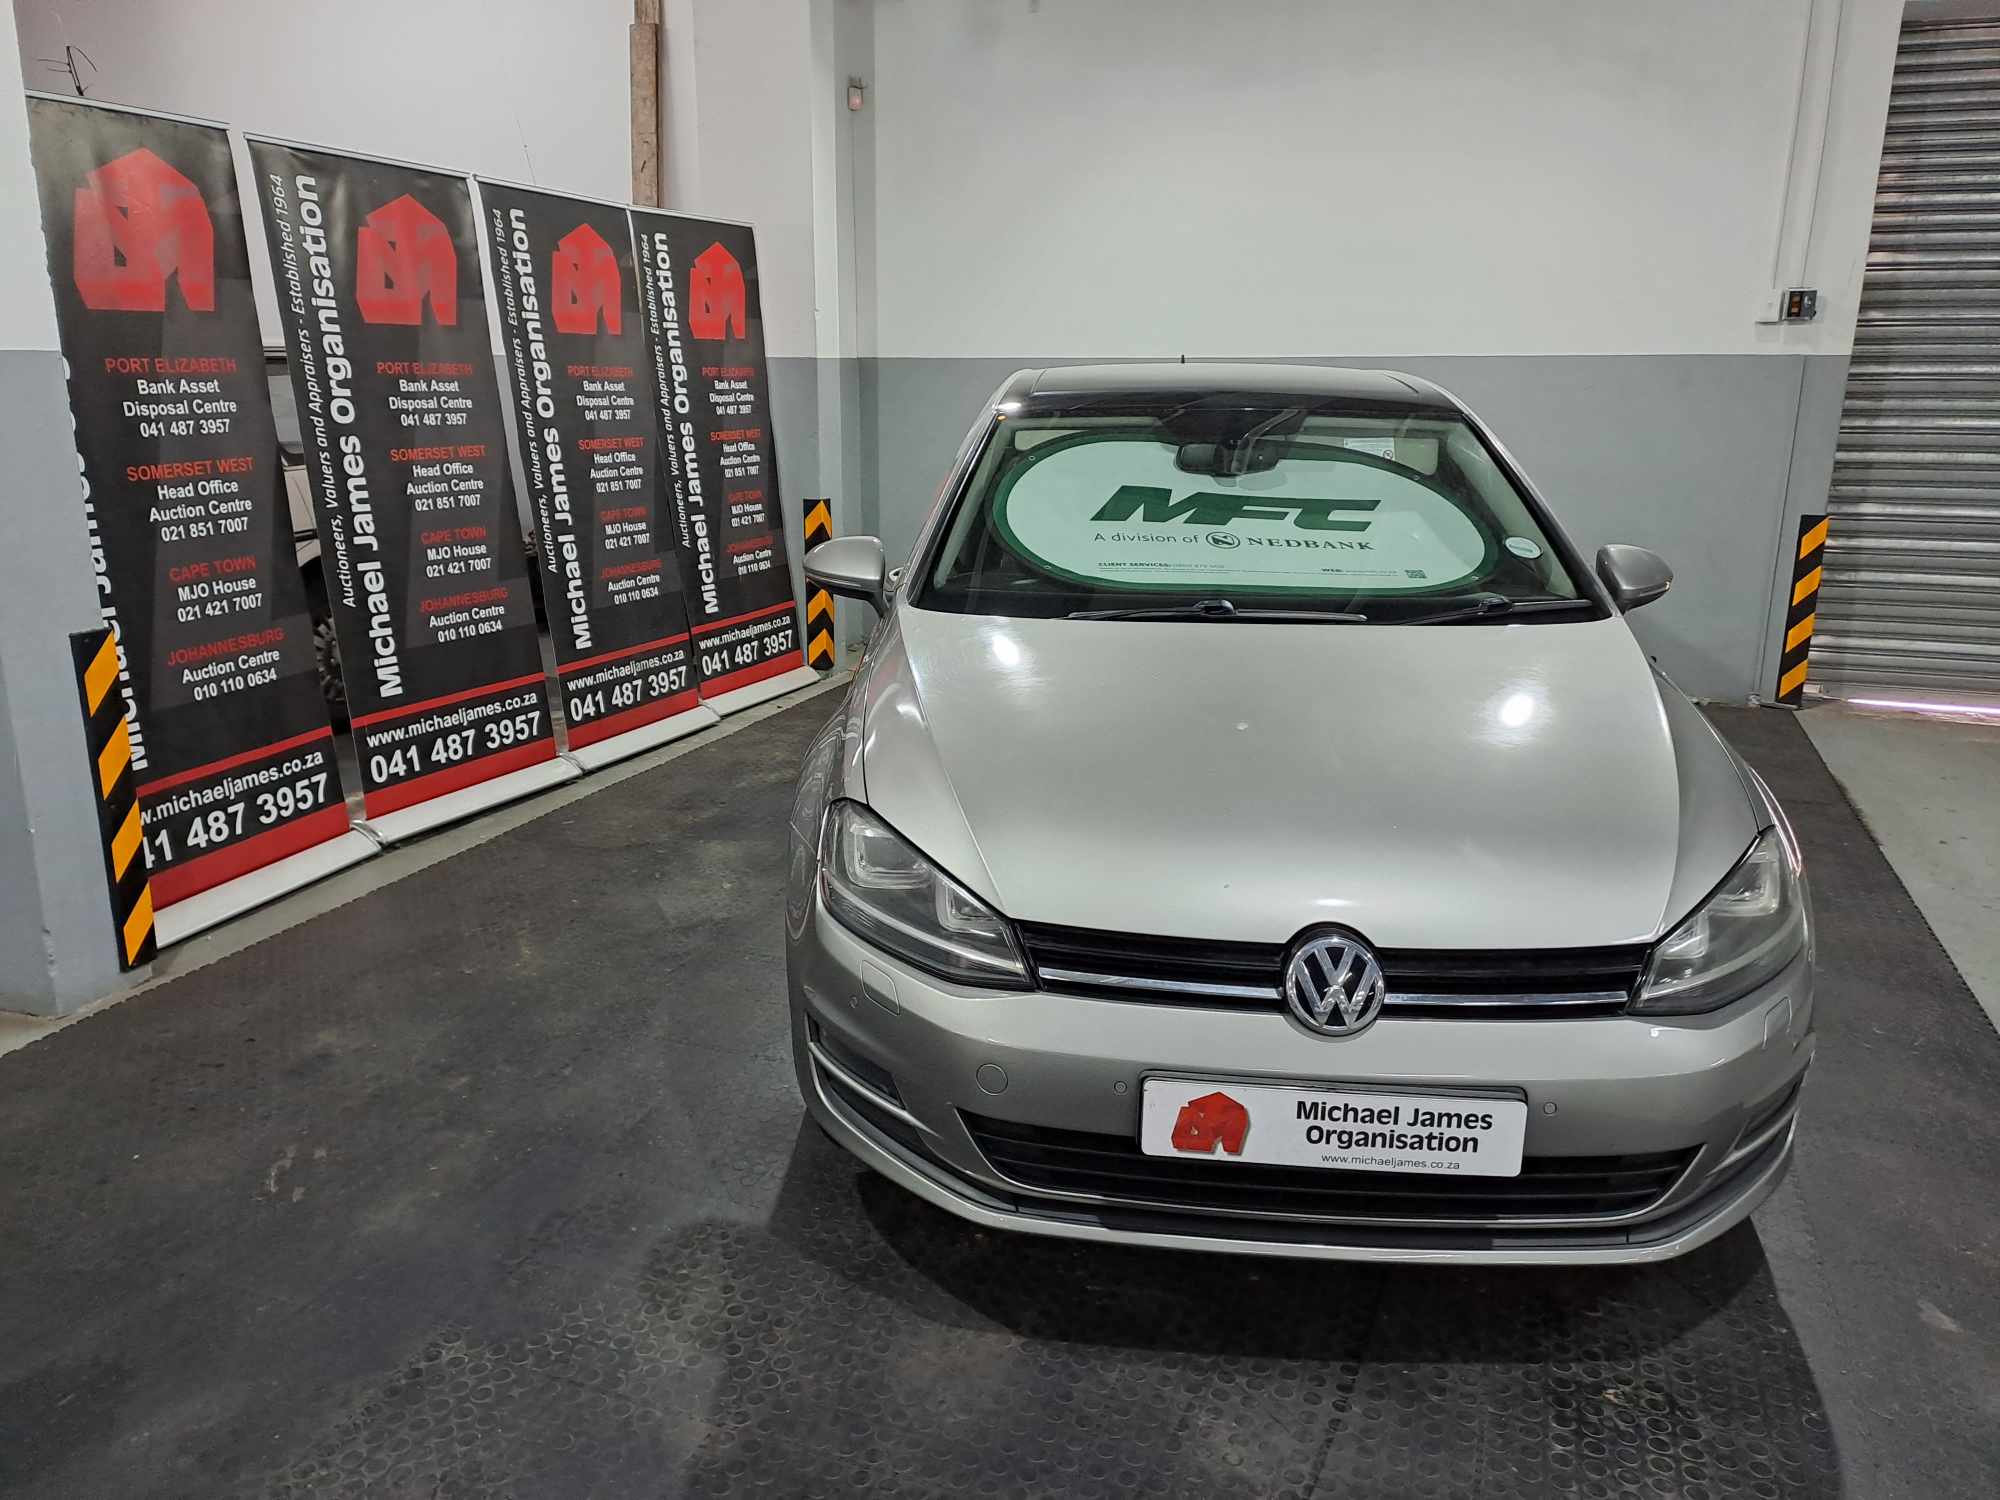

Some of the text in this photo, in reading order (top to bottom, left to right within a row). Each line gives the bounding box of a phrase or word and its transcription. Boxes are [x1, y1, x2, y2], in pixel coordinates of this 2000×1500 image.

[640, 234, 651, 264] 1964
[643, 265, 660, 336] Established
[105, 357, 236, 373] PORT ELIZABETH
[376, 362, 410, 375] PORT
[654, 342, 671, 408] Appraisers
[137, 378, 220, 395] Bank Asset
[269, 174, 356, 608] Auctioneers, Valuers and Appraisers Established 1964
[399, 379, 460, 392] Bank Asset
[492, 208, 558, 574] Auctioneers, Valuers and Appraisers Established 1964
[583, 380, 625, 392] Bank Asset
[122, 400, 237, 419] Disposal Centre
[388, 396, 472, 411] Disposal Centre
[576, 396, 634, 408] Disposal Centre
[400, 413, 467, 426] 041 487 3957
[584, 410, 598, 420] 041
[614, 409, 631, 420] 3957
[661, 408, 673, 431] and
[140, 418, 230, 438] 041 487 3957
[390, 444, 486, 462] SOMERSET WEST
[594, 452, 636, 464] Head Office
[666, 433, 680, 476] Valuers
[127, 457, 254, 481] SOMERSET WEST
[412, 462, 474, 478] Head Office
[544, 427, 573, 526] James
[590, 466, 644, 479] Auction Centre
[680, 422, 704, 508] James
[157, 480, 238, 500] Head Office
[339, 436, 378, 552] James
[406, 479, 484, 495] Auction Centre
[596, 482, 608, 493] 021
[625, 478, 642, 490] 7007
[150, 499, 252, 522] Auction Centre
[415, 494, 480, 512] 021 851 7007
[1089, 485, 1382, 532] MFC
[161, 517, 248, 542] 021 851 7007
[421, 527, 487, 544] CAPE TOWN
[605, 522, 646, 535] MJO House
[1094, 532, 1199, 544] A division of
[426, 544, 487, 561] MJO House
[605, 533, 650, 550] 021 421 7007
[1247, 537, 1375, 550] NEDBANK
[168, 556, 256, 582] CAPE TOWN
[426, 558, 492, 578] 021 421 7007
[690, 514, 719, 614] Michael
[178, 577, 256, 602] MJO House
[557, 533, 592, 650] Michael
[608, 574, 660, 592] Auction Centre
[177, 593, 262, 622] 021 421 7007
[614, 594, 627, 605] 010
[628, 591, 640, 602] 110
[430, 605, 506, 628] Auction Centre
[357, 560, 404, 698] Michael
[438, 619, 503, 643] 010 110 0634
[699, 616, 791, 650] www.michaeljames.co.za
[168, 627, 285, 666] JOHANNESBURG
[702, 630, 793, 676] 041 487 3957
[182, 650, 280, 684] Auction Centre
[567, 648, 685, 692] www.michaeljames.co.za
[194, 668, 277, 700] 010 110 0634
[570, 665, 688, 722] 041 487 3957
[366, 692, 538, 748] www.michaeljames.co.za
[370, 710, 541, 784] 041 487 3957
[186, 802, 246, 849] 487
[256, 772, 328, 825] 3957
[1296, 1100, 1493, 1130] Michael James
[1306, 1125, 1479, 1153] Organisation
[1321, 1153, 1460, 1170] www.michaeljames.co.za
